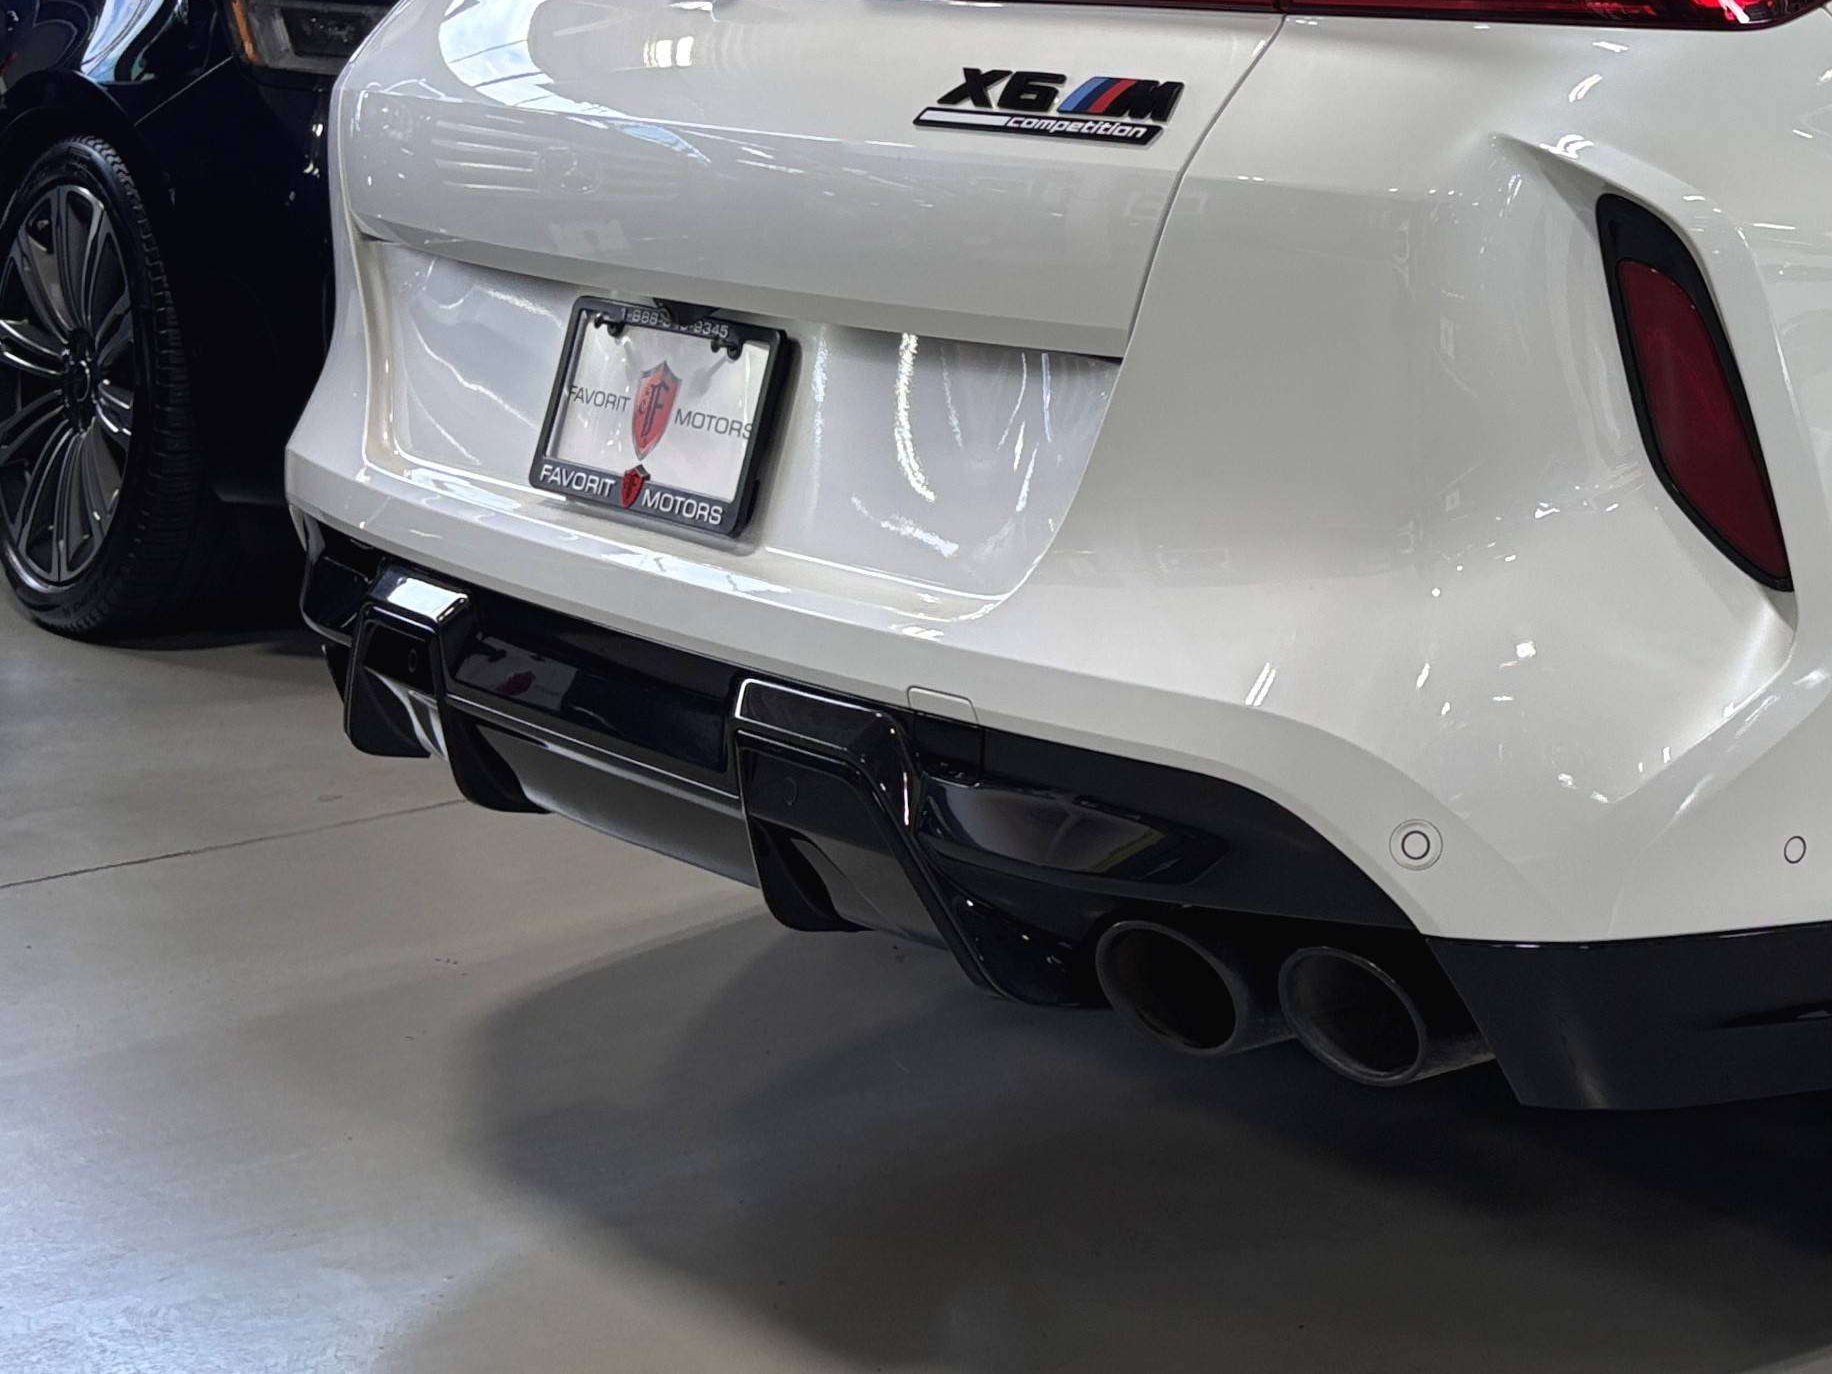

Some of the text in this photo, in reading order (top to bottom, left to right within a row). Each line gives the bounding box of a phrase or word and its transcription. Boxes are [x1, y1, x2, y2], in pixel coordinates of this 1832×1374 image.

[937, 67, 1067, 113] X6
[1005, 115, 1148, 139] competition
[566, 384, 631, 412] FAVORIT
[674, 408, 753, 439] MOTORS
[539, 464, 723, 525] FAVORIT MOTORS
